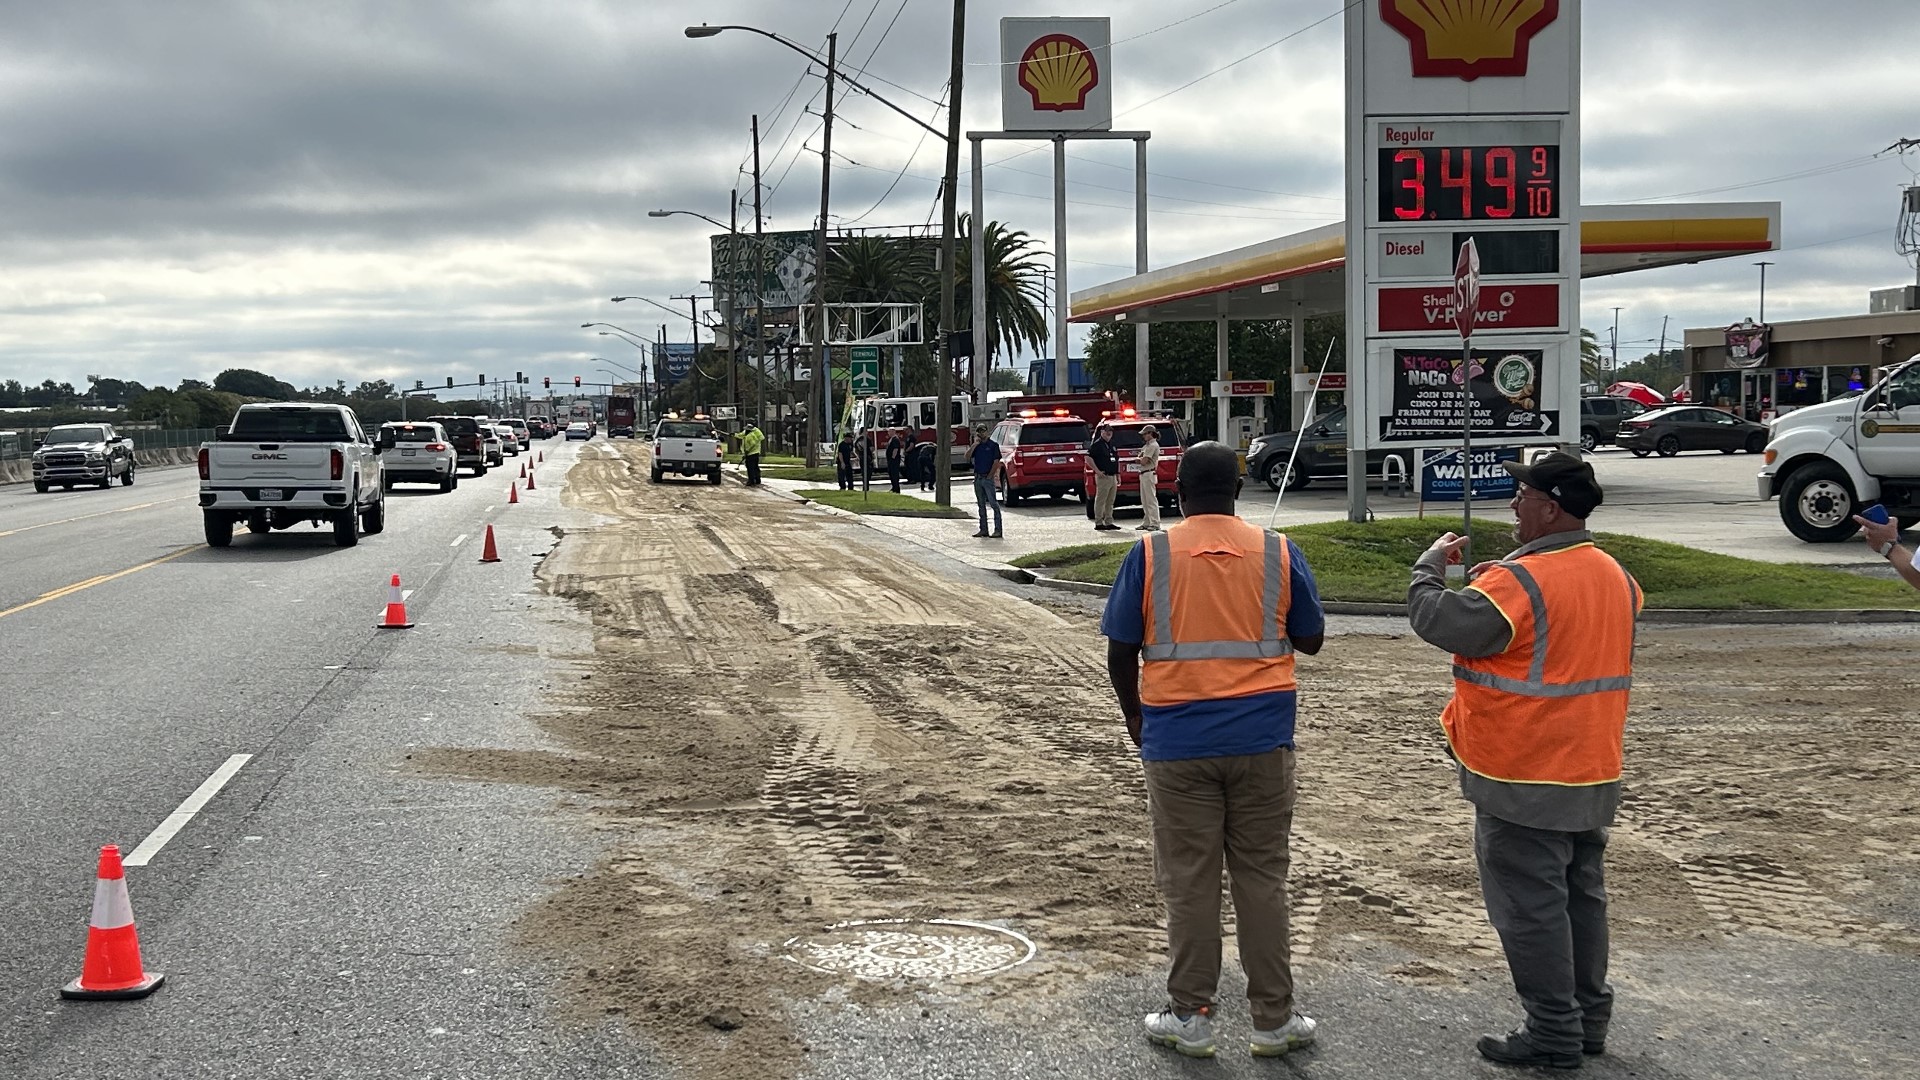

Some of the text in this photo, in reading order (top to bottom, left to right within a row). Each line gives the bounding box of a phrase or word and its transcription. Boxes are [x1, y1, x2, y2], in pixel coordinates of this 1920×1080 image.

[1386, 126, 1435, 145] Regular
[1531, 147, 1548, 178] 9
[1394, 147, 1517, 220] 3.49
[1527, 187, 1552, 217] 10
[1386, 240, 1425, 256] Diesel
[1423, 294, 1454, 307] Shell
[1424, 307, 1507, 323] V-Pwer
[1416, 391, 1440, 399] JOIN
[1442, 391, 1455, 399] US
[1410, 400, 1438, 408] CINCO
[1440, 400, 1453, 408] DE
[1397, 409, 1431, 417] FRIDAY
[1433, 409, 1451, 417] 5TH
[1473, 409, 1492, 417] DAY
[1410, 418, 1445, 426] DRINKS
[1469, 418, 1494, 426] FOOD
[1455, 451, 1497, 464] Scott
[1432, 477, 1514, 488] COUNC AT-LARGE
